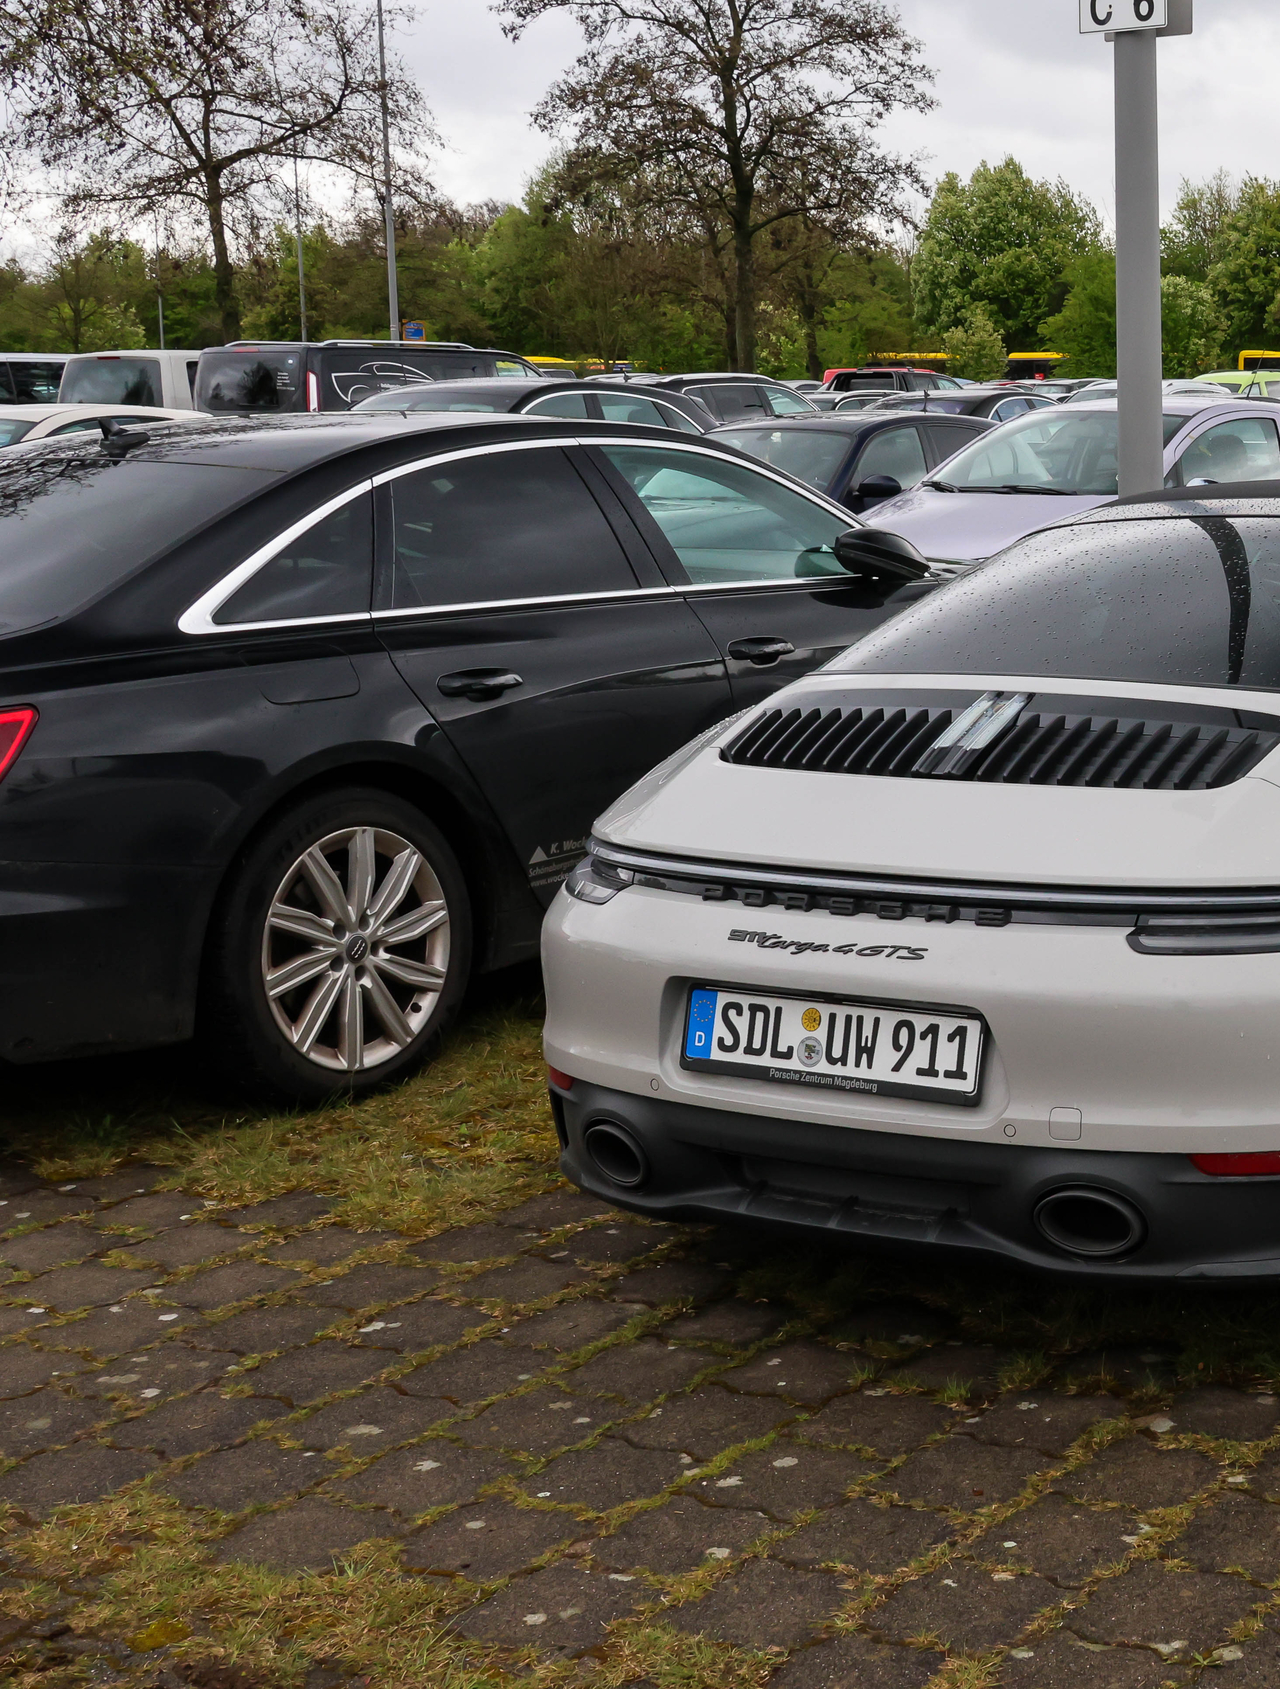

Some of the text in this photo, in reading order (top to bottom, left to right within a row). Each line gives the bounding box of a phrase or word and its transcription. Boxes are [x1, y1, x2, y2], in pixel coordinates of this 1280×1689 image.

[1090, 0, 1112, 26] C
[550, 842, 560, 854] K.
[702, 884, 1012, 928] PORSCHE
[832, 943, 858, 955] 4
[855, 944, 929, 961] GTS
[694, 1031, 705, 1047] D
[717, 1001, 794, 1061] SDL
[824, 1012, 881, 1070] UW
[891, 1019, 968, 1081] 911
[769, 1068, 878, 1093] Porsche Zentrum Magdeburg
